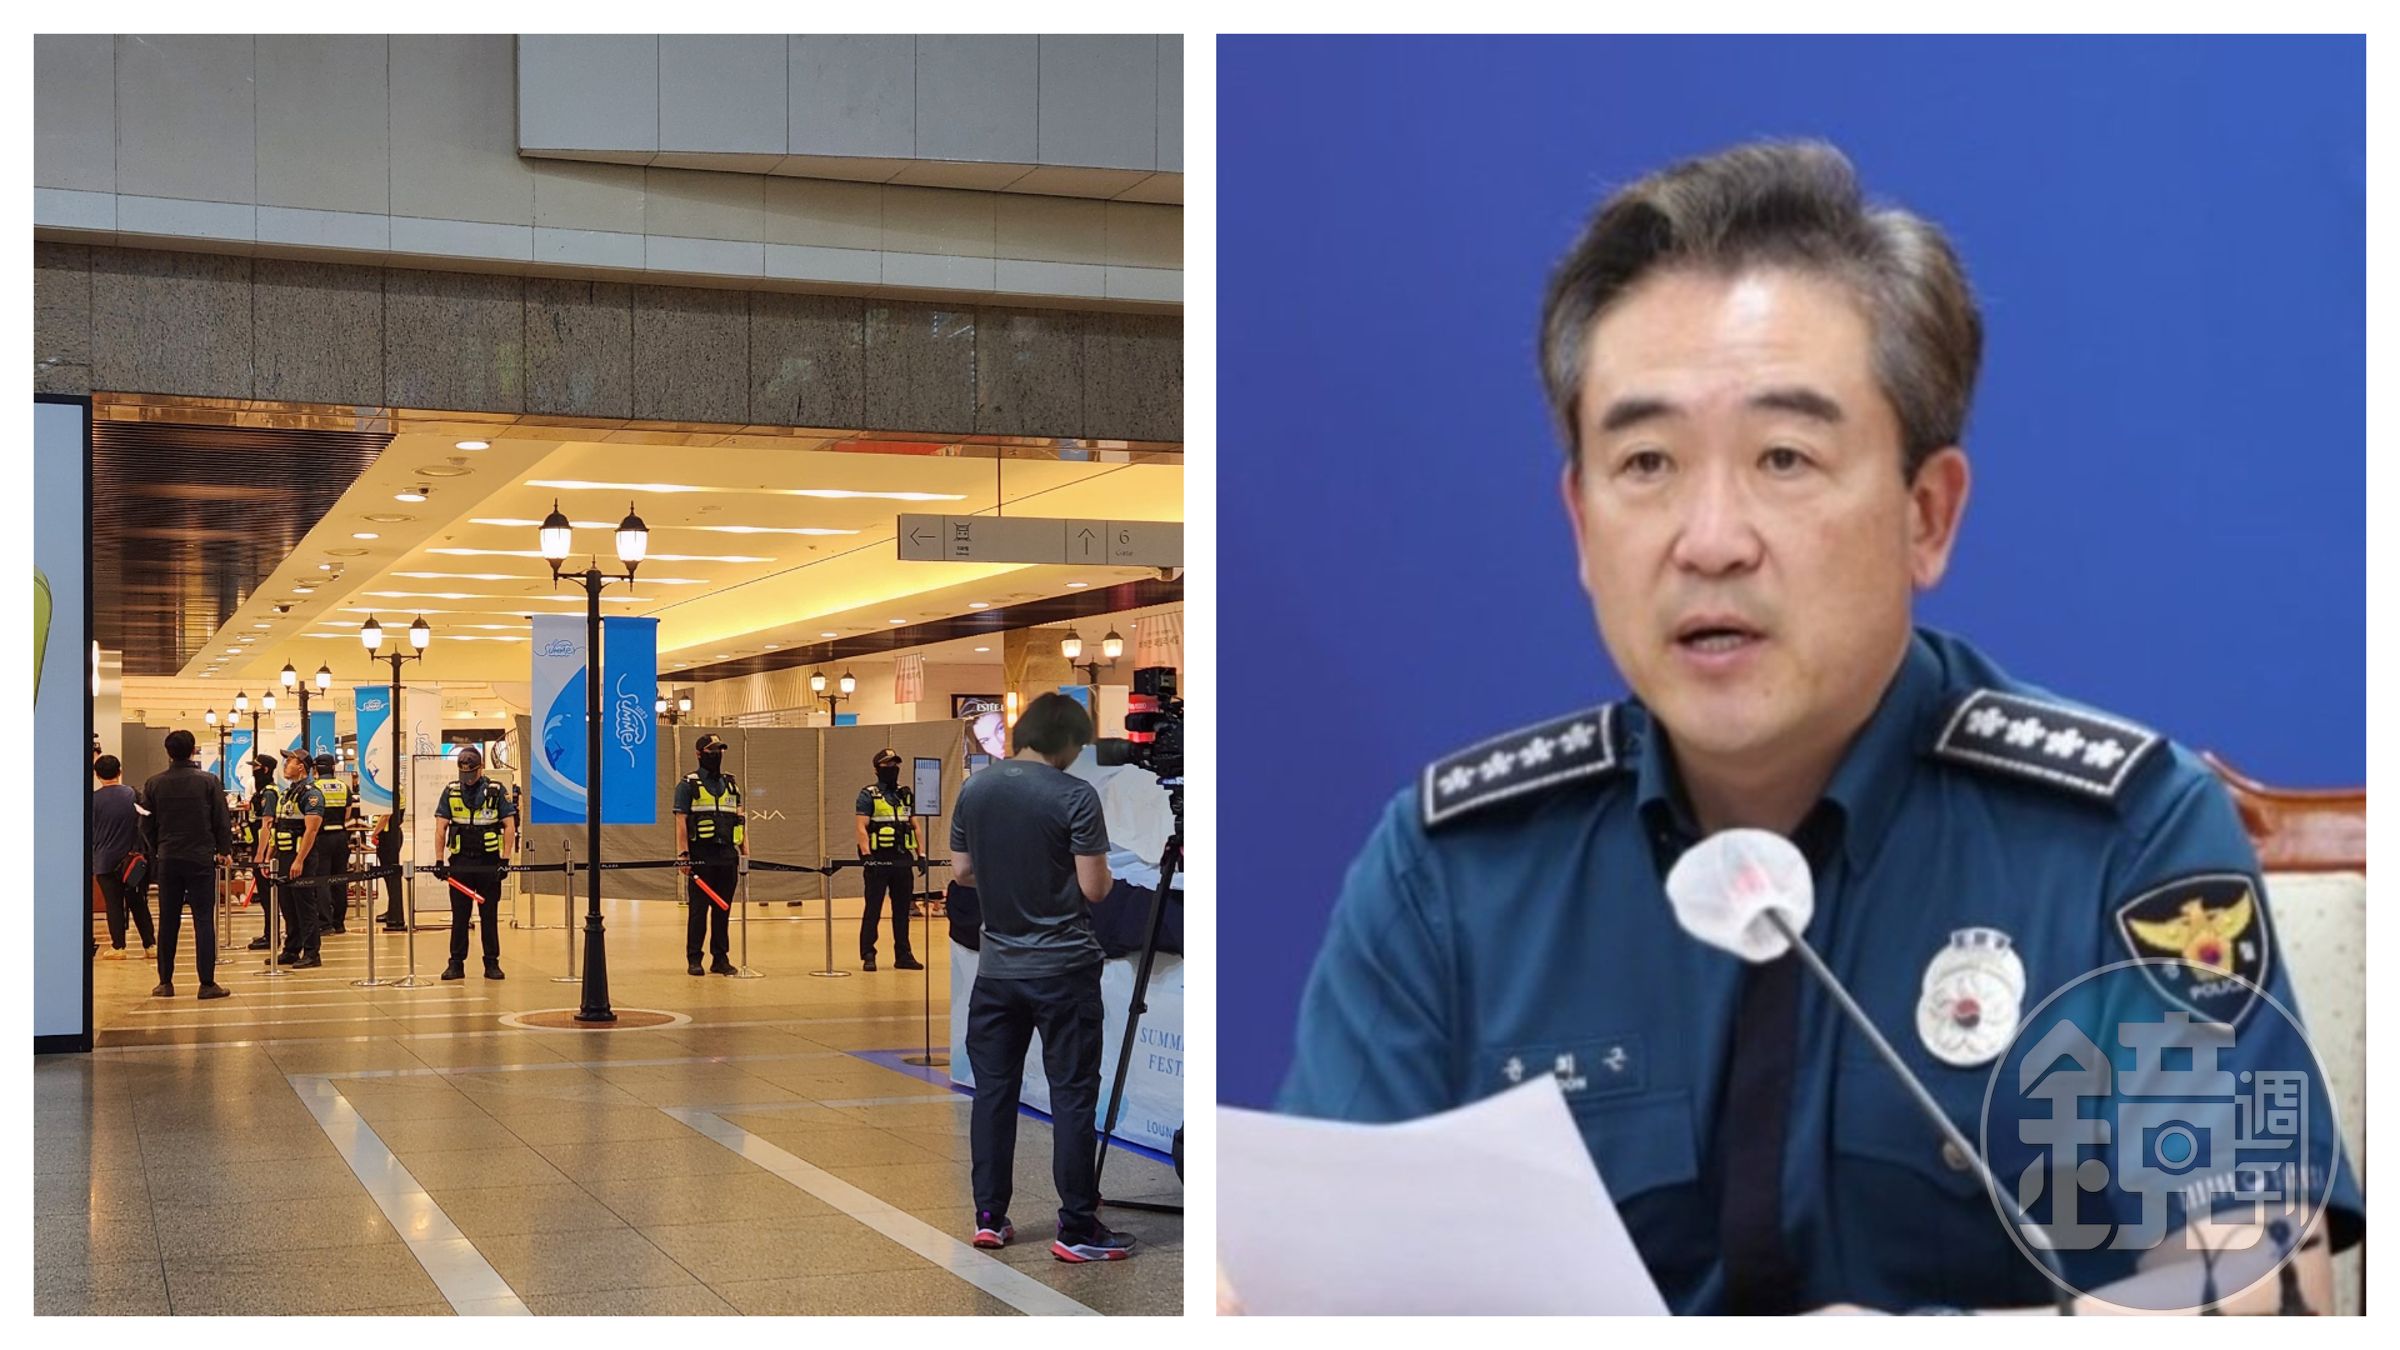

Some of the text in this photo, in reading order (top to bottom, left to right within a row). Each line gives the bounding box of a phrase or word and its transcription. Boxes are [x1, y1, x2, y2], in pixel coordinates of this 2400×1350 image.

[1119, 529, 1130, 545] 6
[1140, 1026, 1184, 1053] SUMM
[1148, 1053, 1184, 1078] FEST
[1146, 1119, 1173, 1139] LOUN
